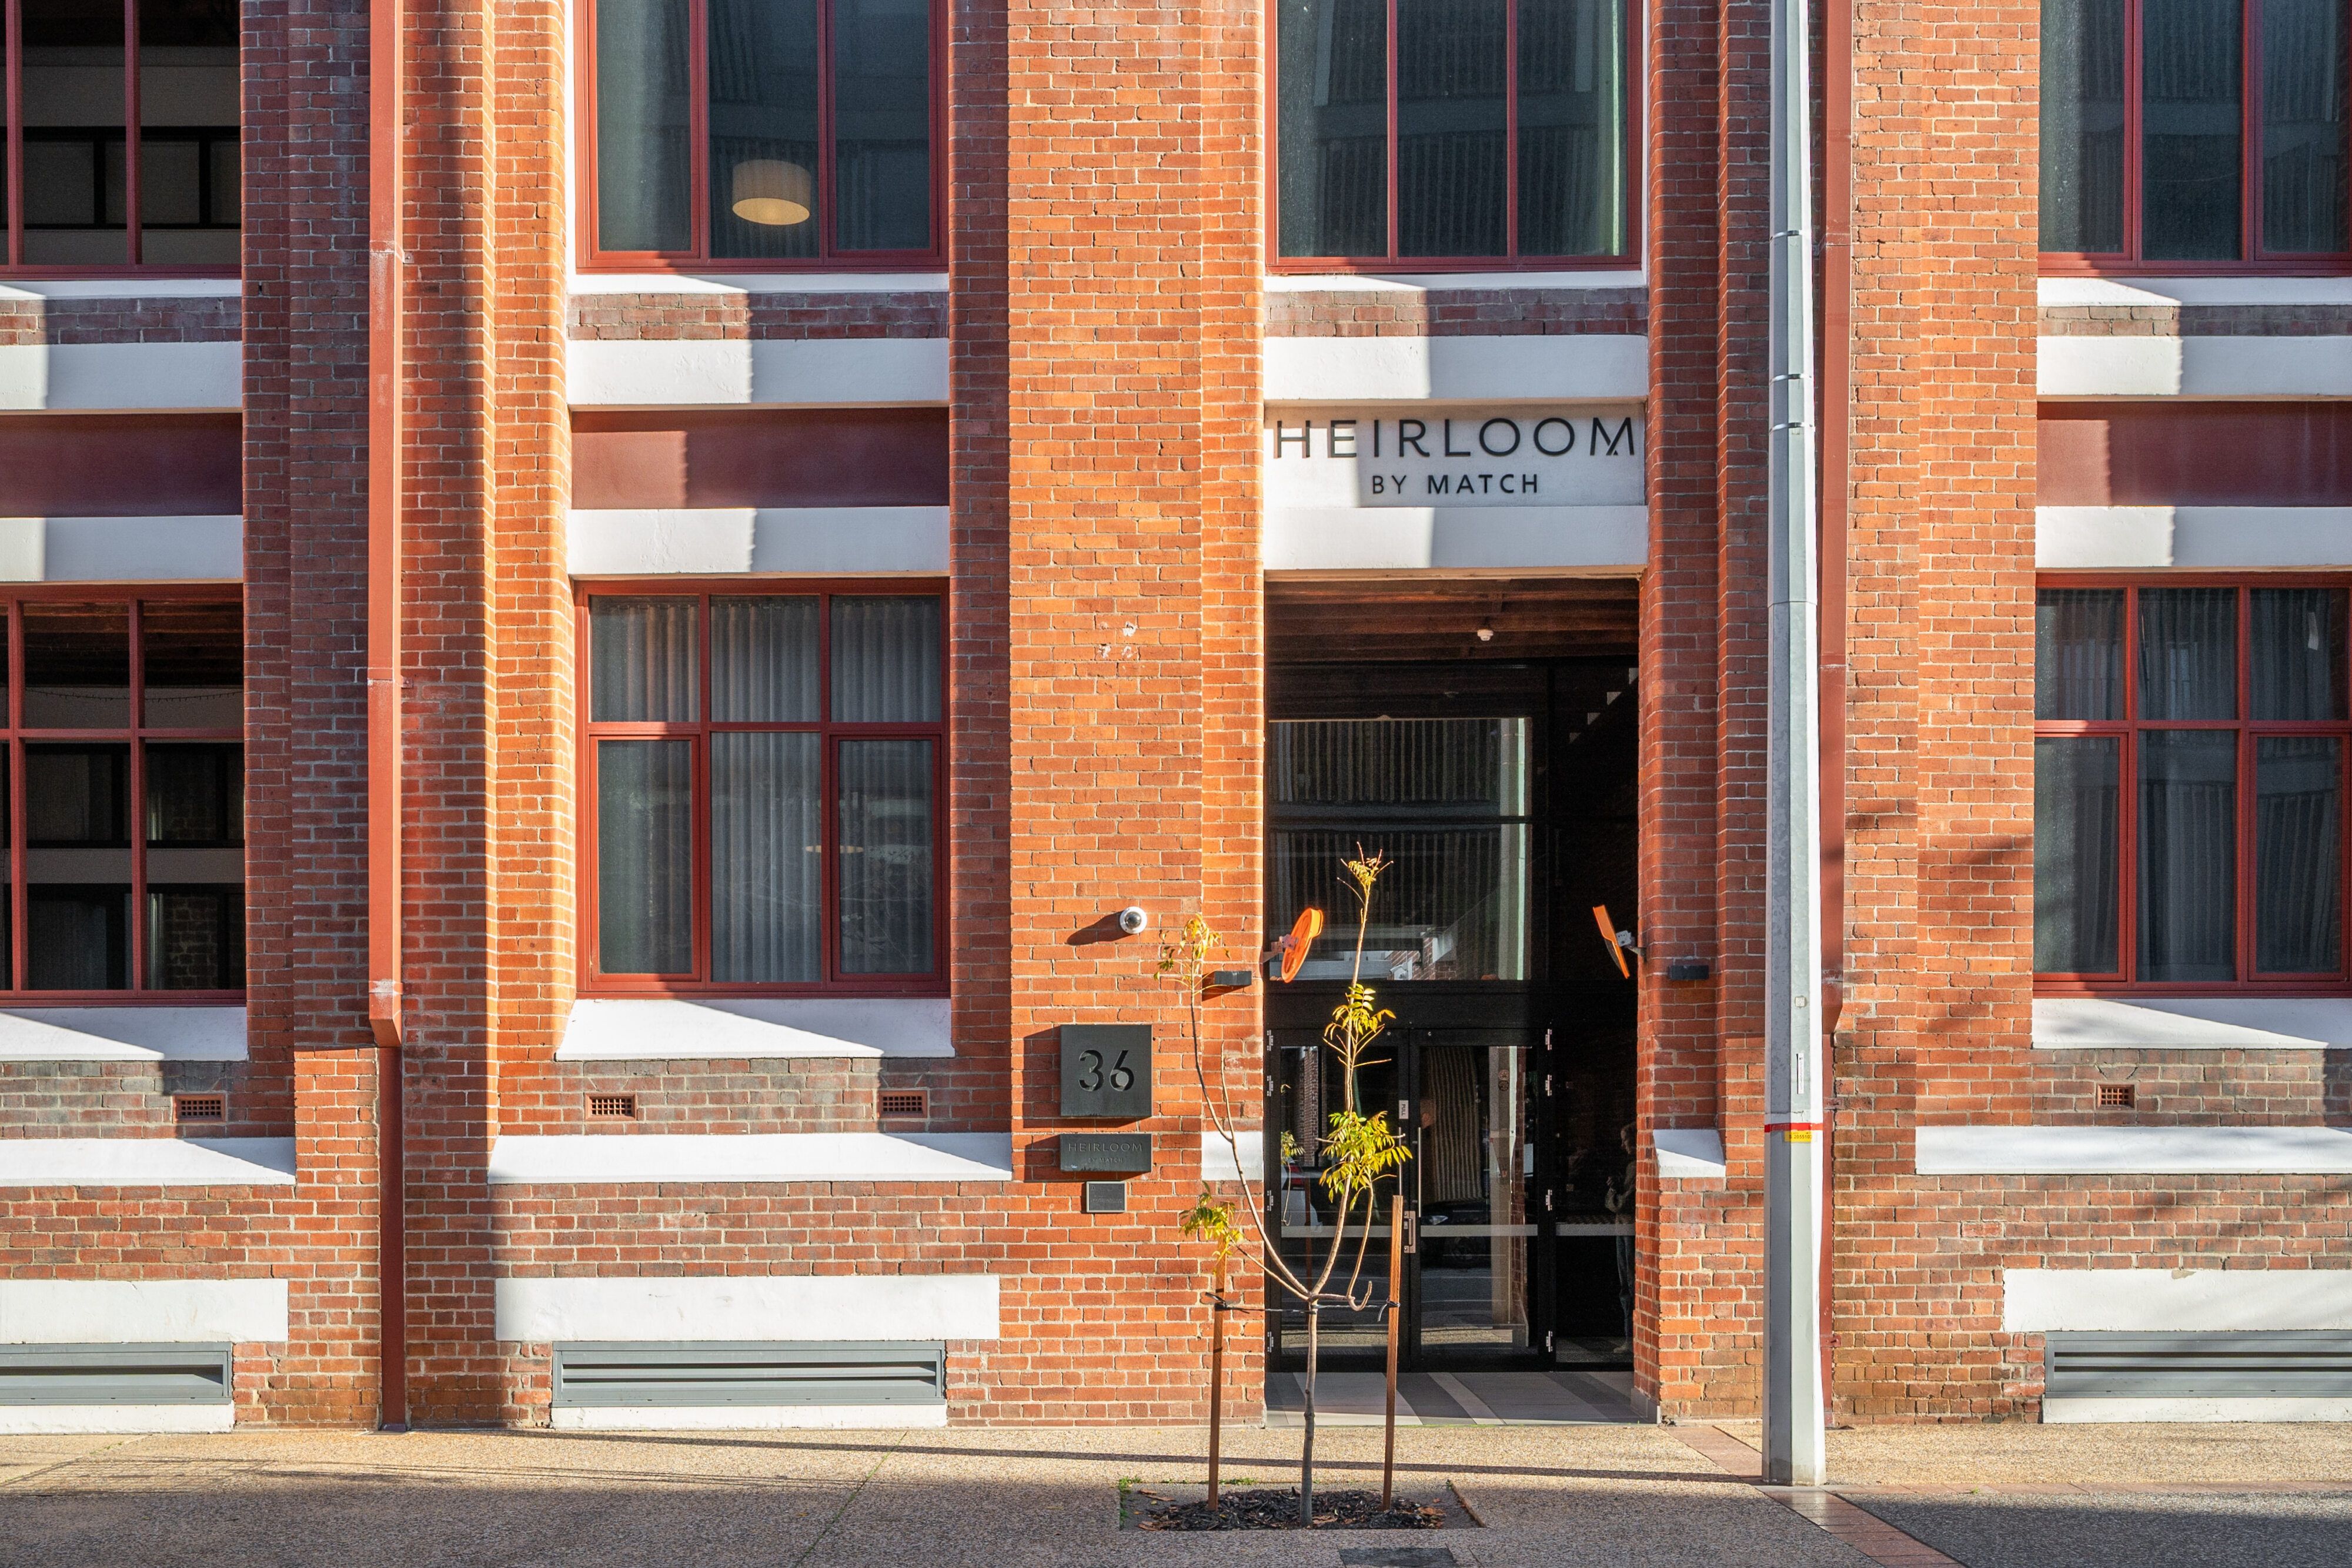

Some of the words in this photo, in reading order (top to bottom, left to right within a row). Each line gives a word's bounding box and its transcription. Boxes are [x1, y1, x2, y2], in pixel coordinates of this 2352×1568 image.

[1273, 417, 1635, 459] HEIRLOOM
[1372, 474, 1407, 494] BY
[1428, 473, 1538, 494] MATCH
[1078, 1049, 1135, 1092] 36
[1068, 1142, 1142, 1152] HEIRLOOM
